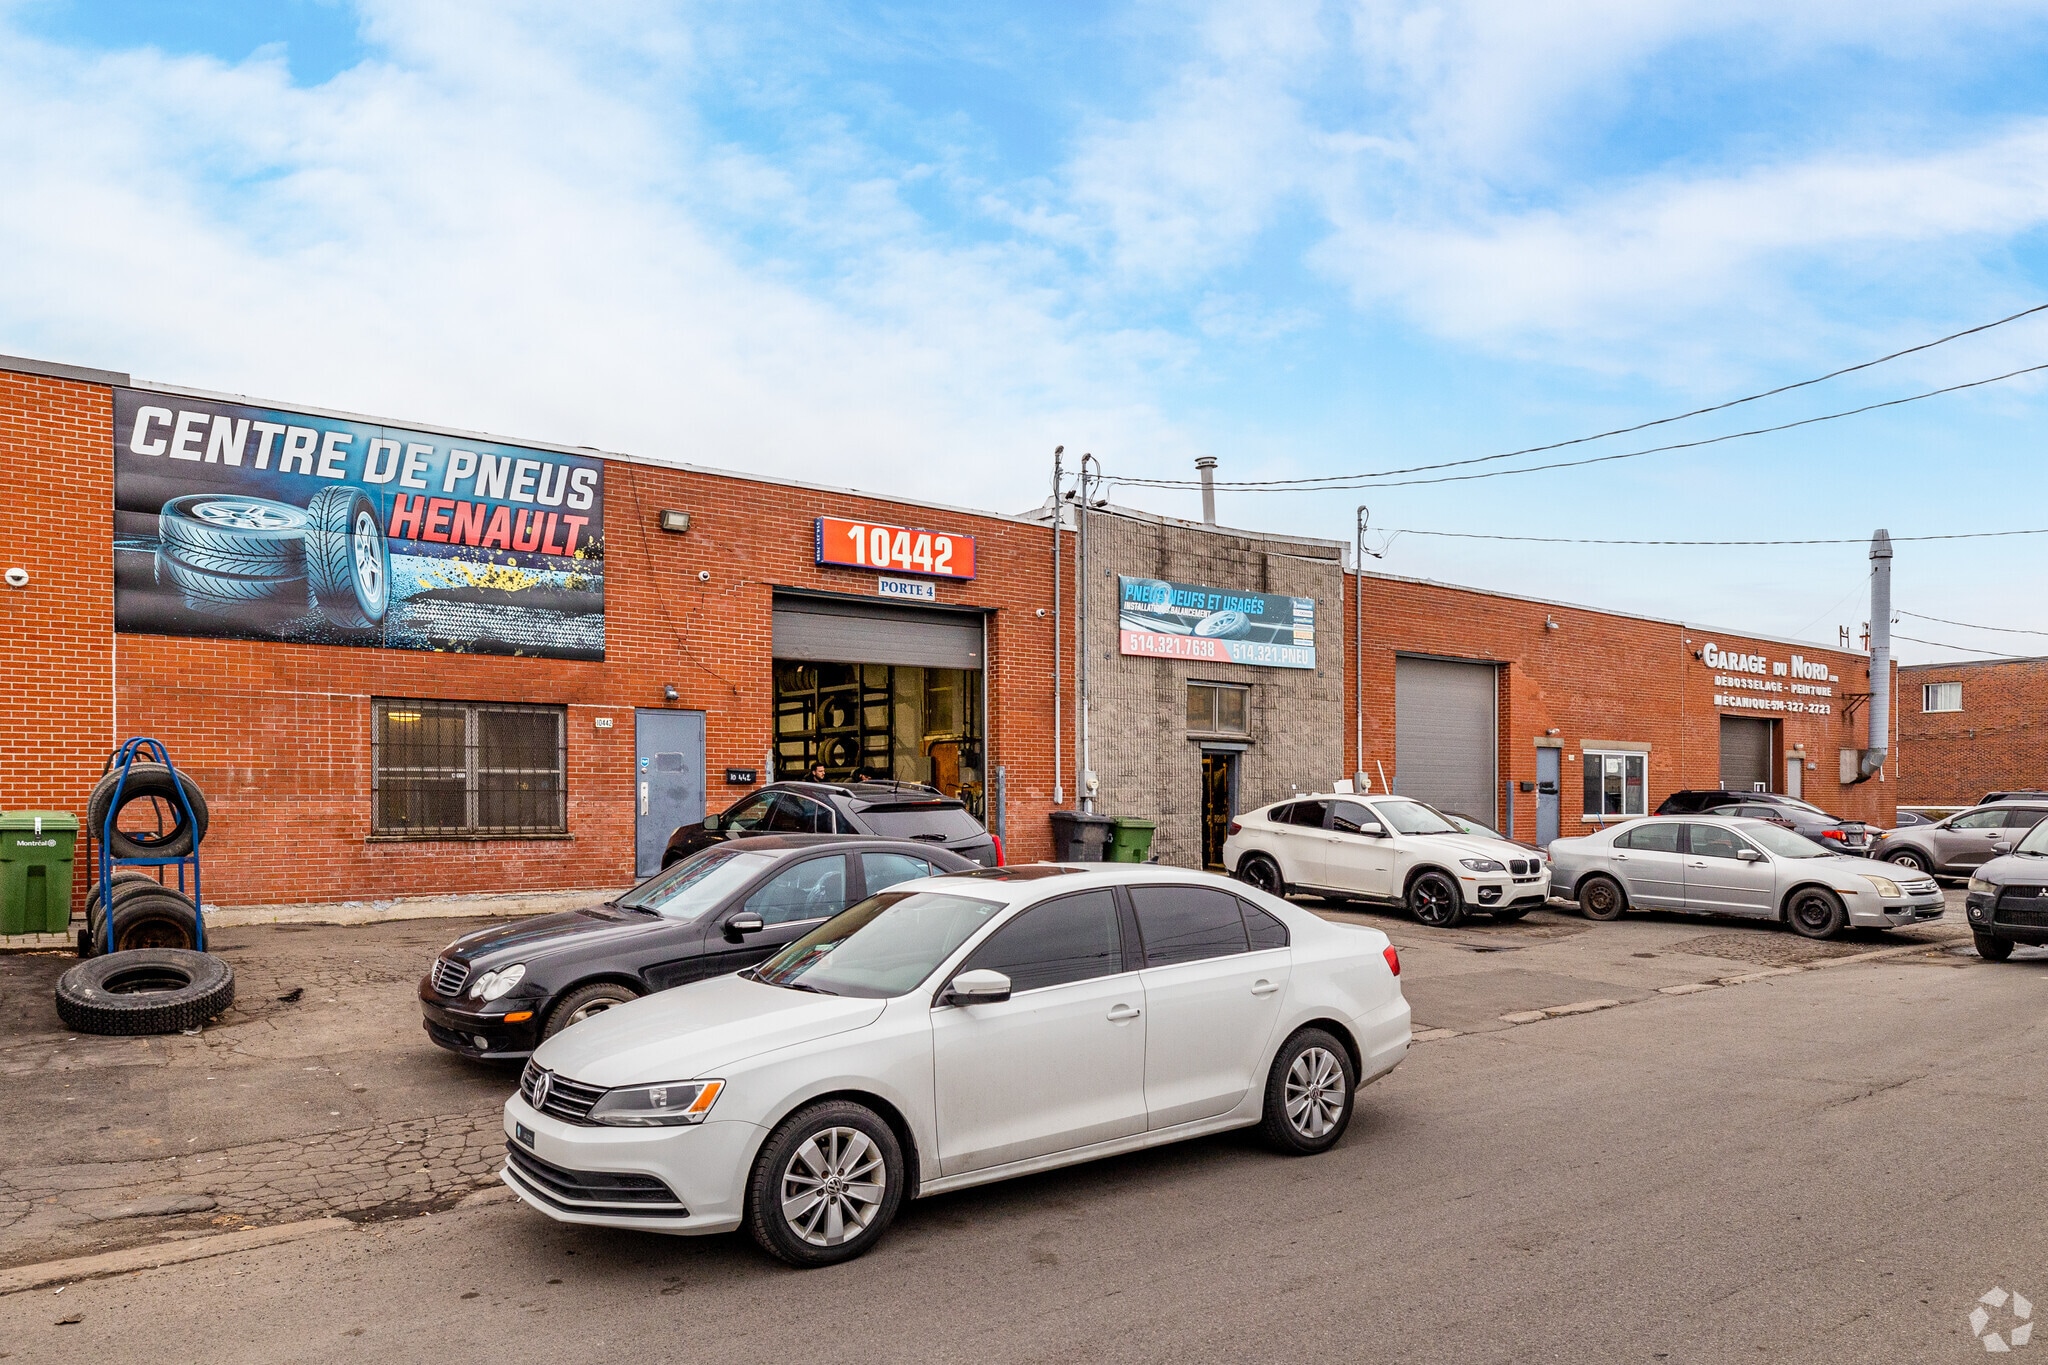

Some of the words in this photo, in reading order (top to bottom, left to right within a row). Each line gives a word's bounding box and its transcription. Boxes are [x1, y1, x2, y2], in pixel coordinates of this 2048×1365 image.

[129, 405, 354, 480] CENTRE
[363, 438, 434, 489] DE
[442, 451, 598, 510] PNEUS
[388, 493, 590, 557] HENAULT
[847, 525, 953, 575] 10442
[881, 581, 923, 596] PORTE
[926, 586, 934, 598] 4
[1125, 584, 1166, 604] PNEUS
[1168, 589, 1205, 609] NEUFS
[1207, 594, 1221, 610] ET
[1222, 596, 1265, 615] USAGÉS
[1130, 634, 1215, 657] 514.321.7638
[1233, 642, 1309, 665] 514.321.PNEU
[1703, 643, 1766, 674] GARAGE
[1773, 661, 1787, 676] DU
[1791, 655, 1828, 681] NORD
[1714, 672, 1783, 692] DÉBOSSELAGE
[1790, 684, 1832, 697] PEINTURE
[597, 718, 612, 727] 10442
[738, 774, 752, 782] 442
